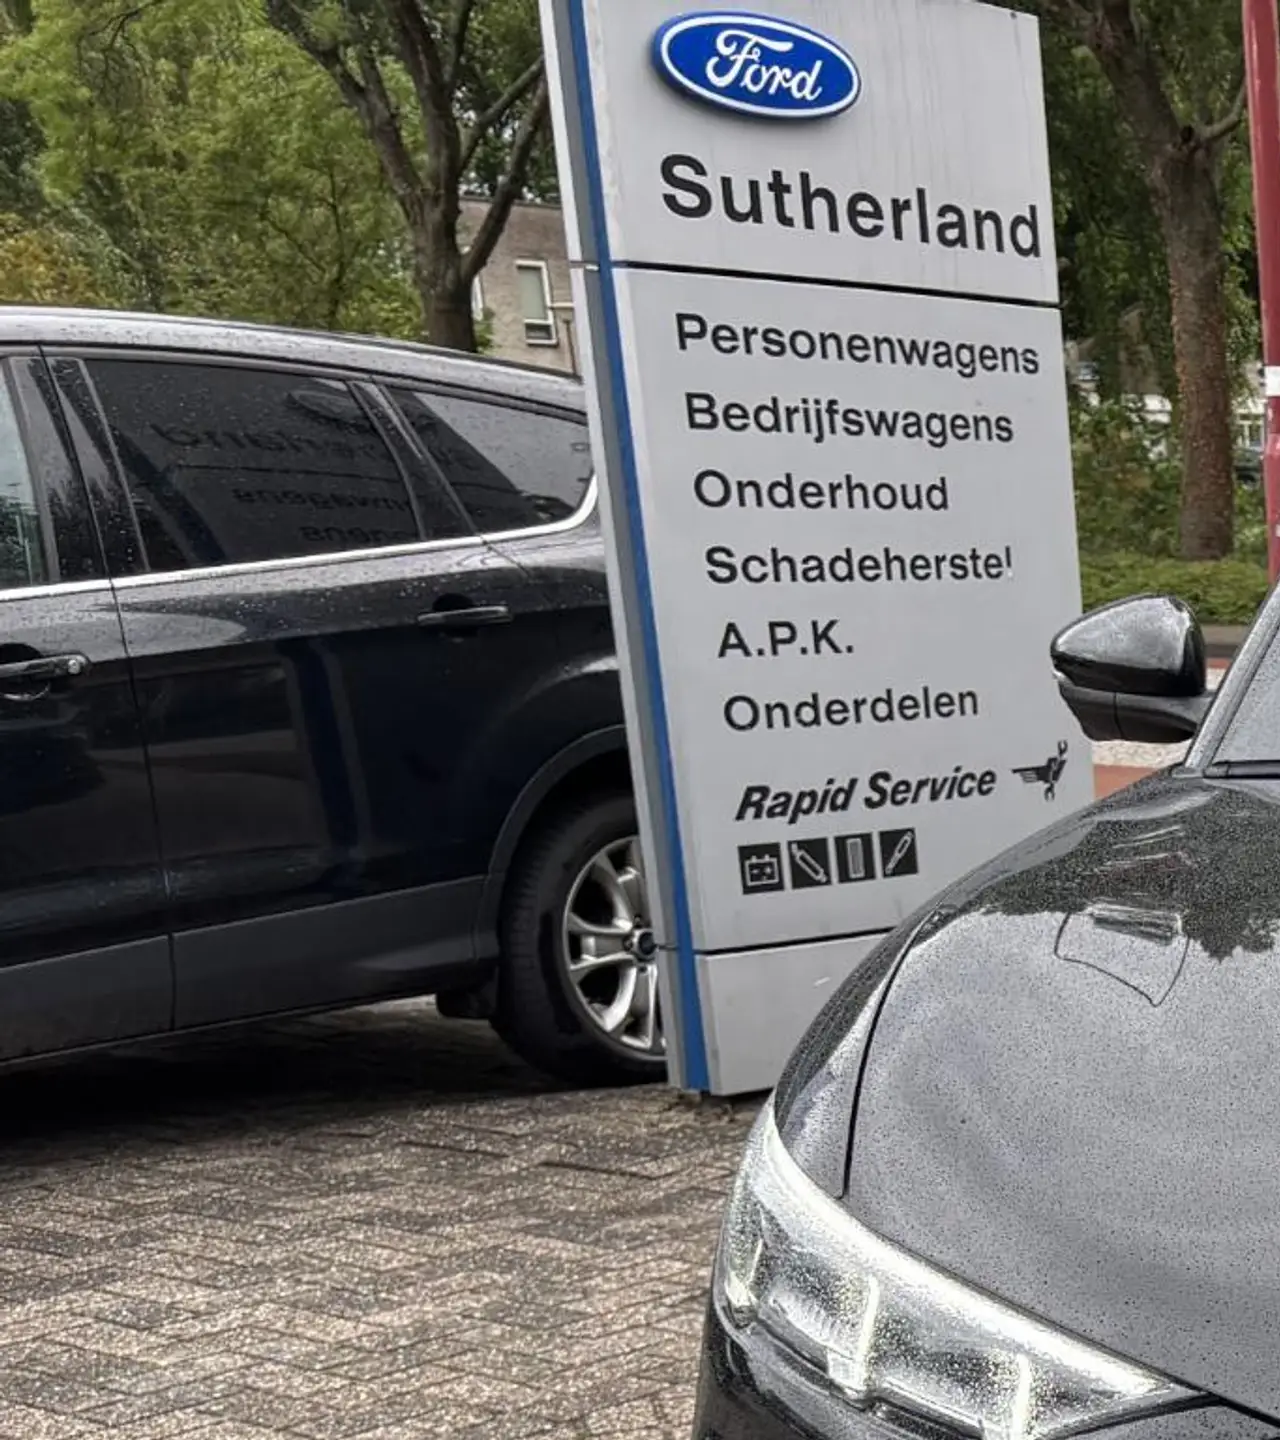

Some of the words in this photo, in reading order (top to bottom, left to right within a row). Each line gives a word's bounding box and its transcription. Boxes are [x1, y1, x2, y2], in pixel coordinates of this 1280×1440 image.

[706, 29, 823, 101] Ford
[660, 154, 1041, 258] Sutherland
[675, 313, 1040, 379] Personenwagens
[685, 392, 1014, 449] Bedrijfswagens
[693, 469, 949, 511] Onderhoud
[718, 619, 854, 659] A.P.K.
[723, 686, 979, 732] Onderdelen
[735, 777, 859, 826] Rapid
[863, 765, 997, 811] Service
